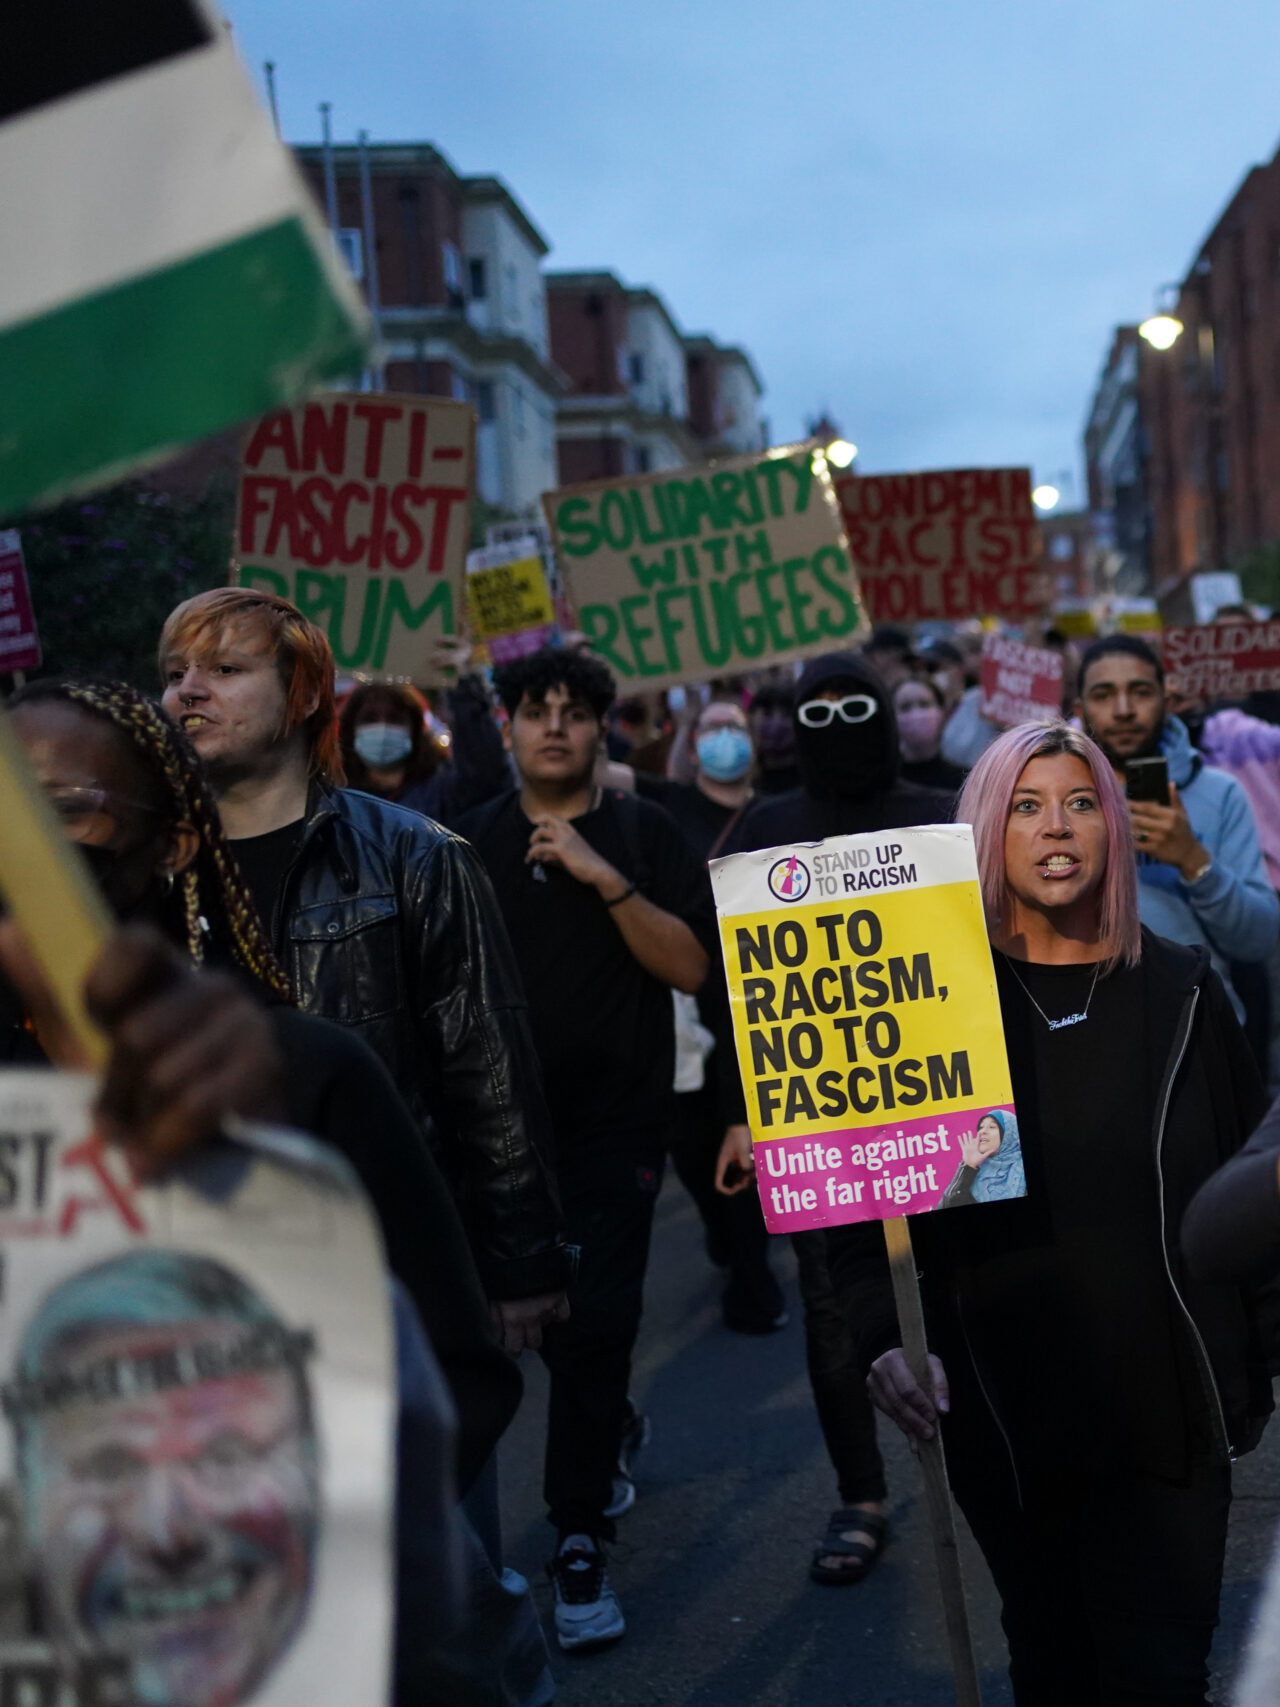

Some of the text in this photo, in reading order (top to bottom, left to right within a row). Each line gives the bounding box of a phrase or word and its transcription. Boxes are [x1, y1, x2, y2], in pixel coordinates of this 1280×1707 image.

[243, 402, 463, 479] ANTI-
[239, 475, 468, 574] FASCIST
[556, 452, 816, 557] SOLIDARITY
[628, 529, 773, 590] WITH
[578, 544, 860, 678] REFUGEES
[813, 843, 903, 875] STAND UP
[816, 863, 918, 897] TO RACISM
[735, 909, 883, 974] NO TO
[742, 952, 949, 1025] RACISM,
[749, 1011, 901, 1076] NO TO
[756, 1050, 974, 1127] FASCISM
[765, 1124, 951, 1178] Unite against
[771, 1163, 939, 1215] the far right
